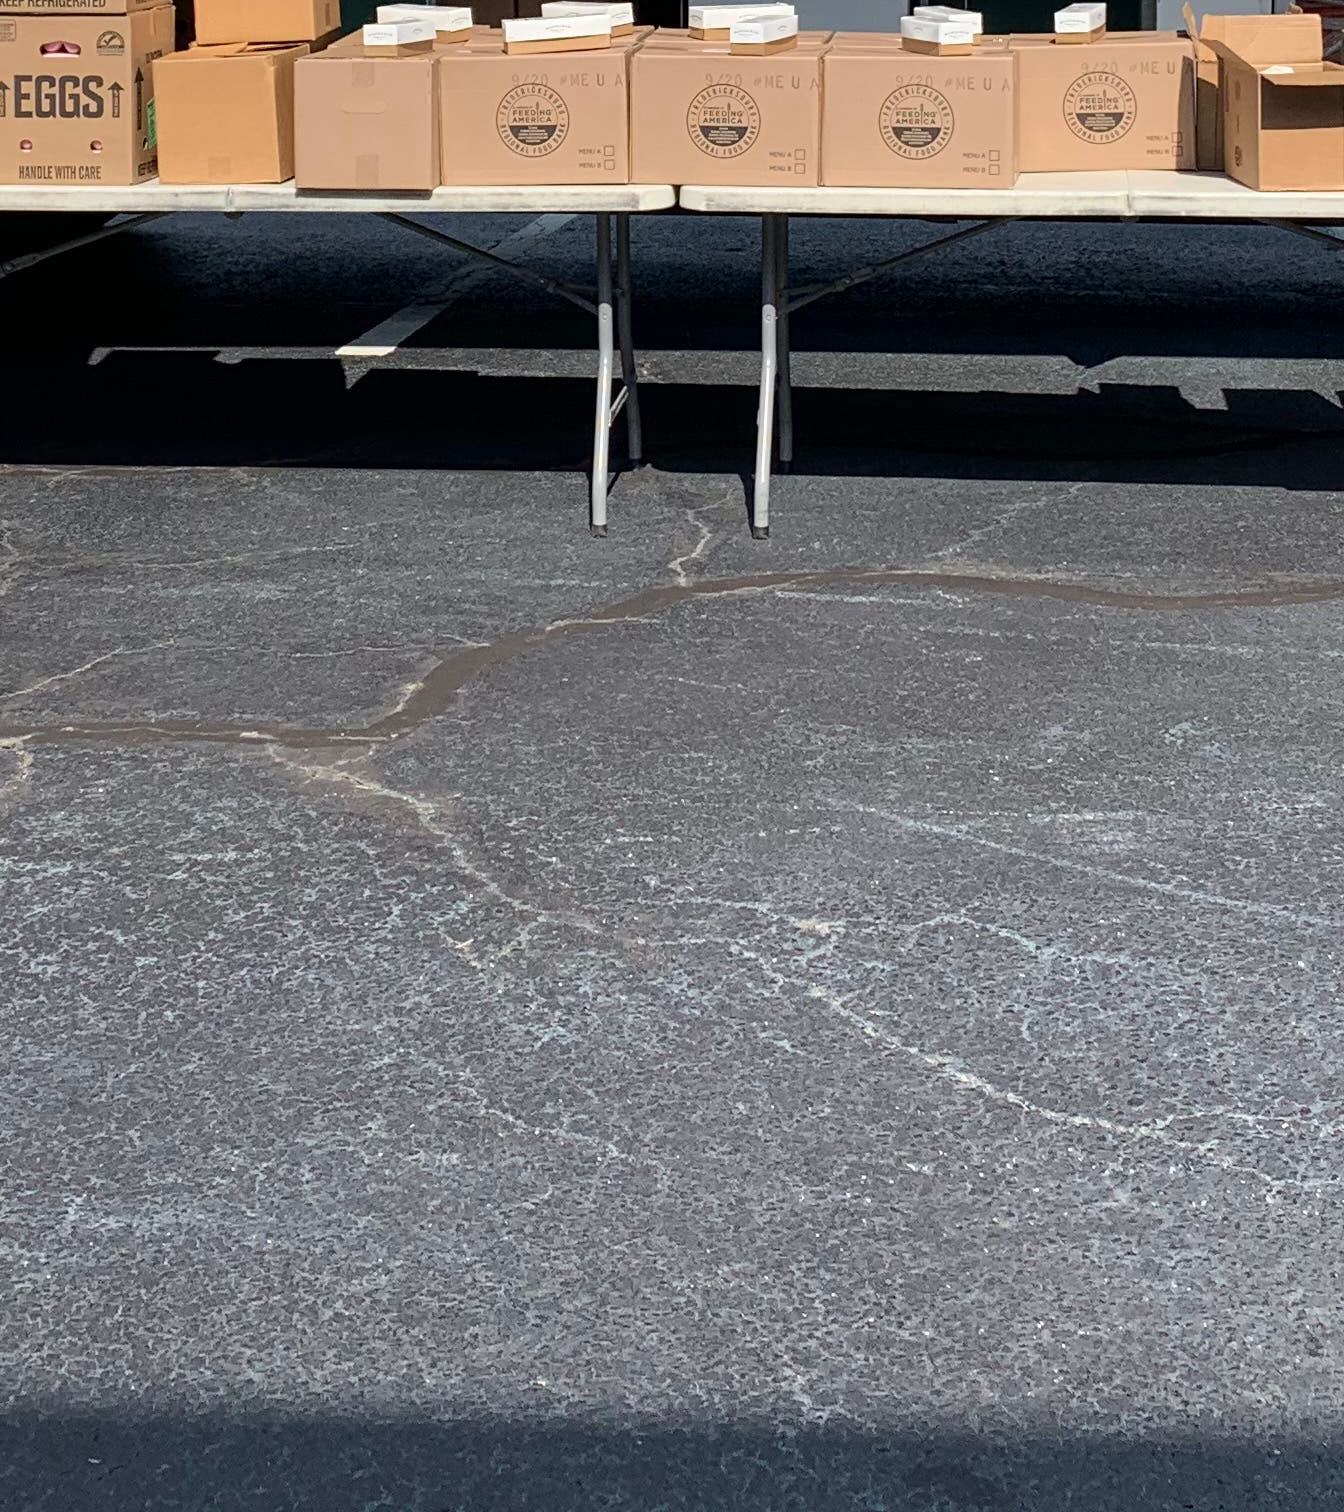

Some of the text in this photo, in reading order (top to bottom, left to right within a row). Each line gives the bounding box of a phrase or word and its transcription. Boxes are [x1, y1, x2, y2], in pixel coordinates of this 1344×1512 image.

[13, 74, 104, 119] EGGS
[18, 165, 102, 180] HANDLE WITH CARE
